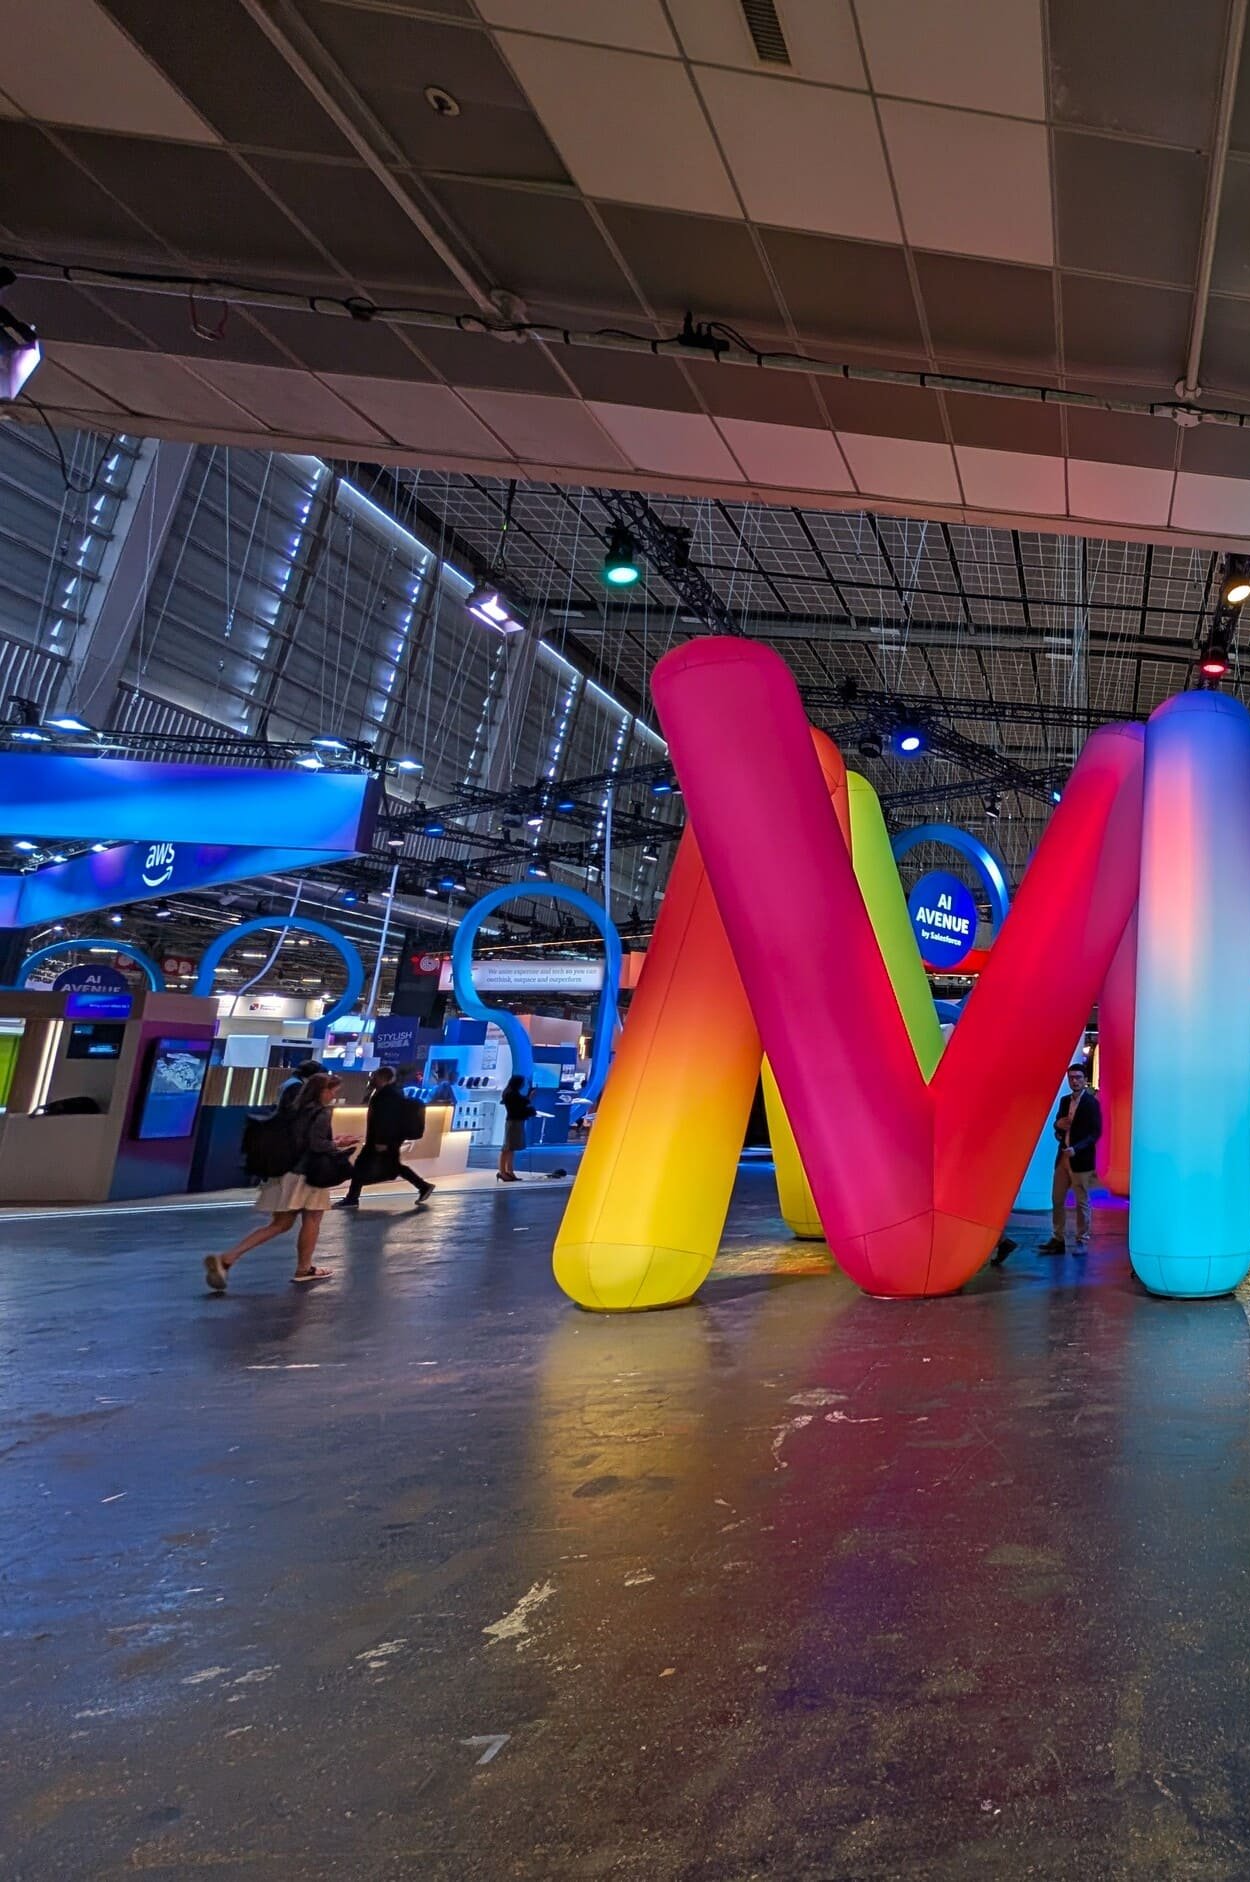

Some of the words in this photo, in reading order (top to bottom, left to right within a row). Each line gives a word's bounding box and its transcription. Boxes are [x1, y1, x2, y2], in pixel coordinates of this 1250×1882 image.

[145, 842, 175, 869] aws
[937, 893, 952, 911] AI
[916, 906, 970, 935] AVENUE
[921, 928, 930, 940] by
[930, 931, 962, 947] Salesforce
[85, 975, 102, 984] AI
[377, 1031, 413, 1042] STYLISH
